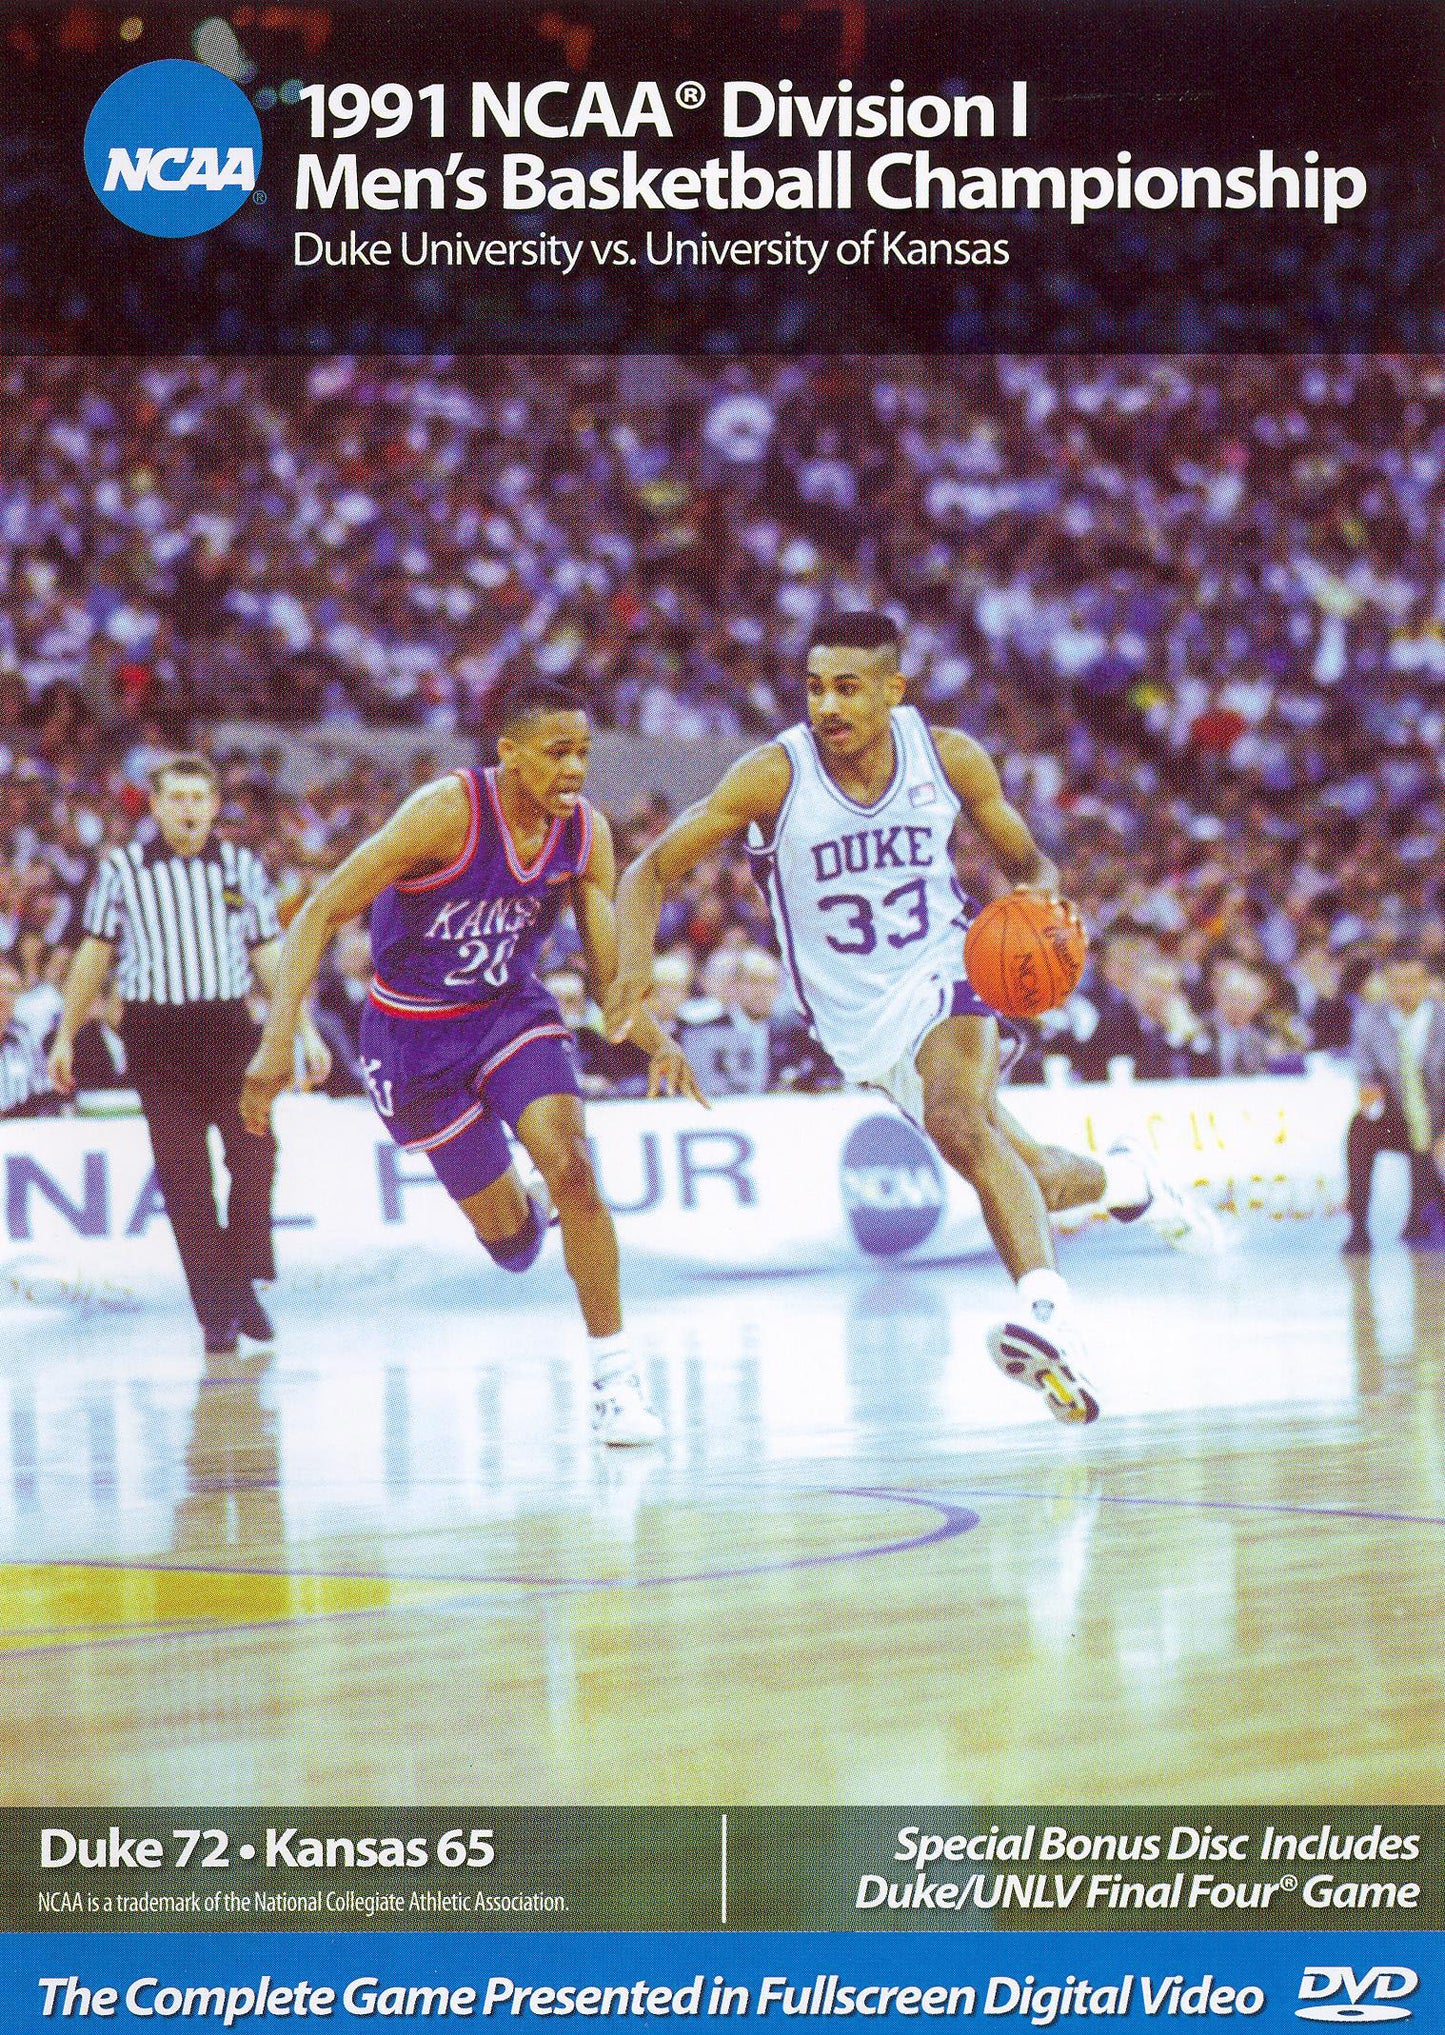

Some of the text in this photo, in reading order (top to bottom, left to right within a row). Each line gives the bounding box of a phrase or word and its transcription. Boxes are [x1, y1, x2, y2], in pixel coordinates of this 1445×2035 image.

[811, 825, 933, 883] DUKE
[817, 876, 930, 956] 33
[374, 1127, 757, 1225] FUR
